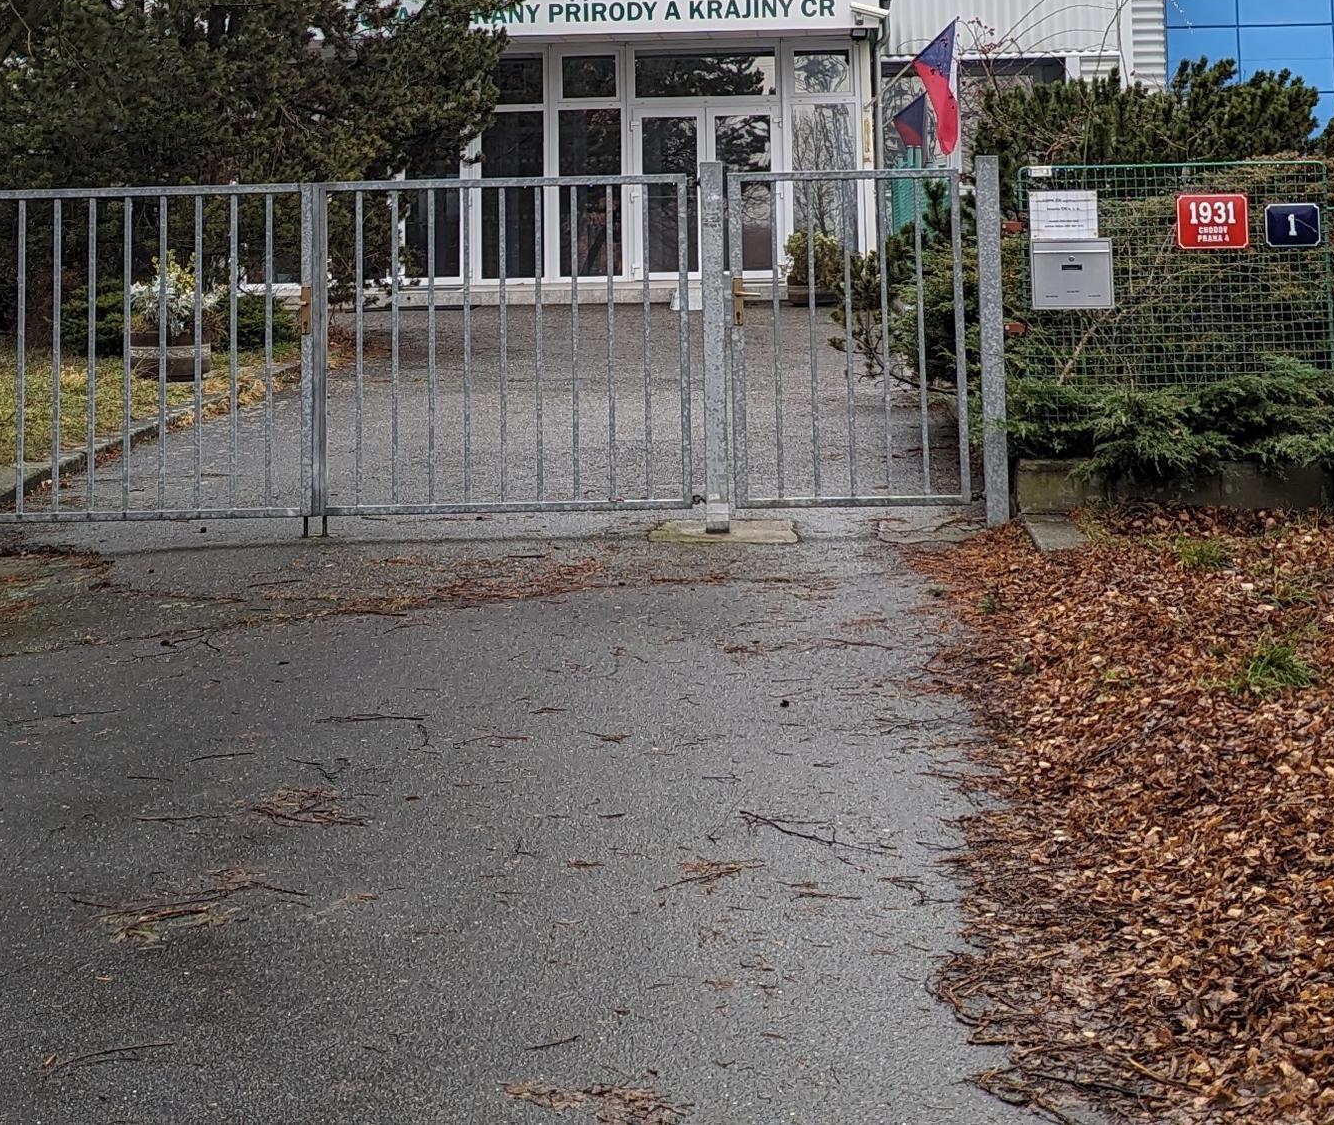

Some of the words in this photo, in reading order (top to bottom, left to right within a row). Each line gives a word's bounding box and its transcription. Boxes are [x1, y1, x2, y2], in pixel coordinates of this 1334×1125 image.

[664, 1, 682, 21] A
[1189, 201, 1236, 224] 1931
[1287, 213, 1298, 236] 1
